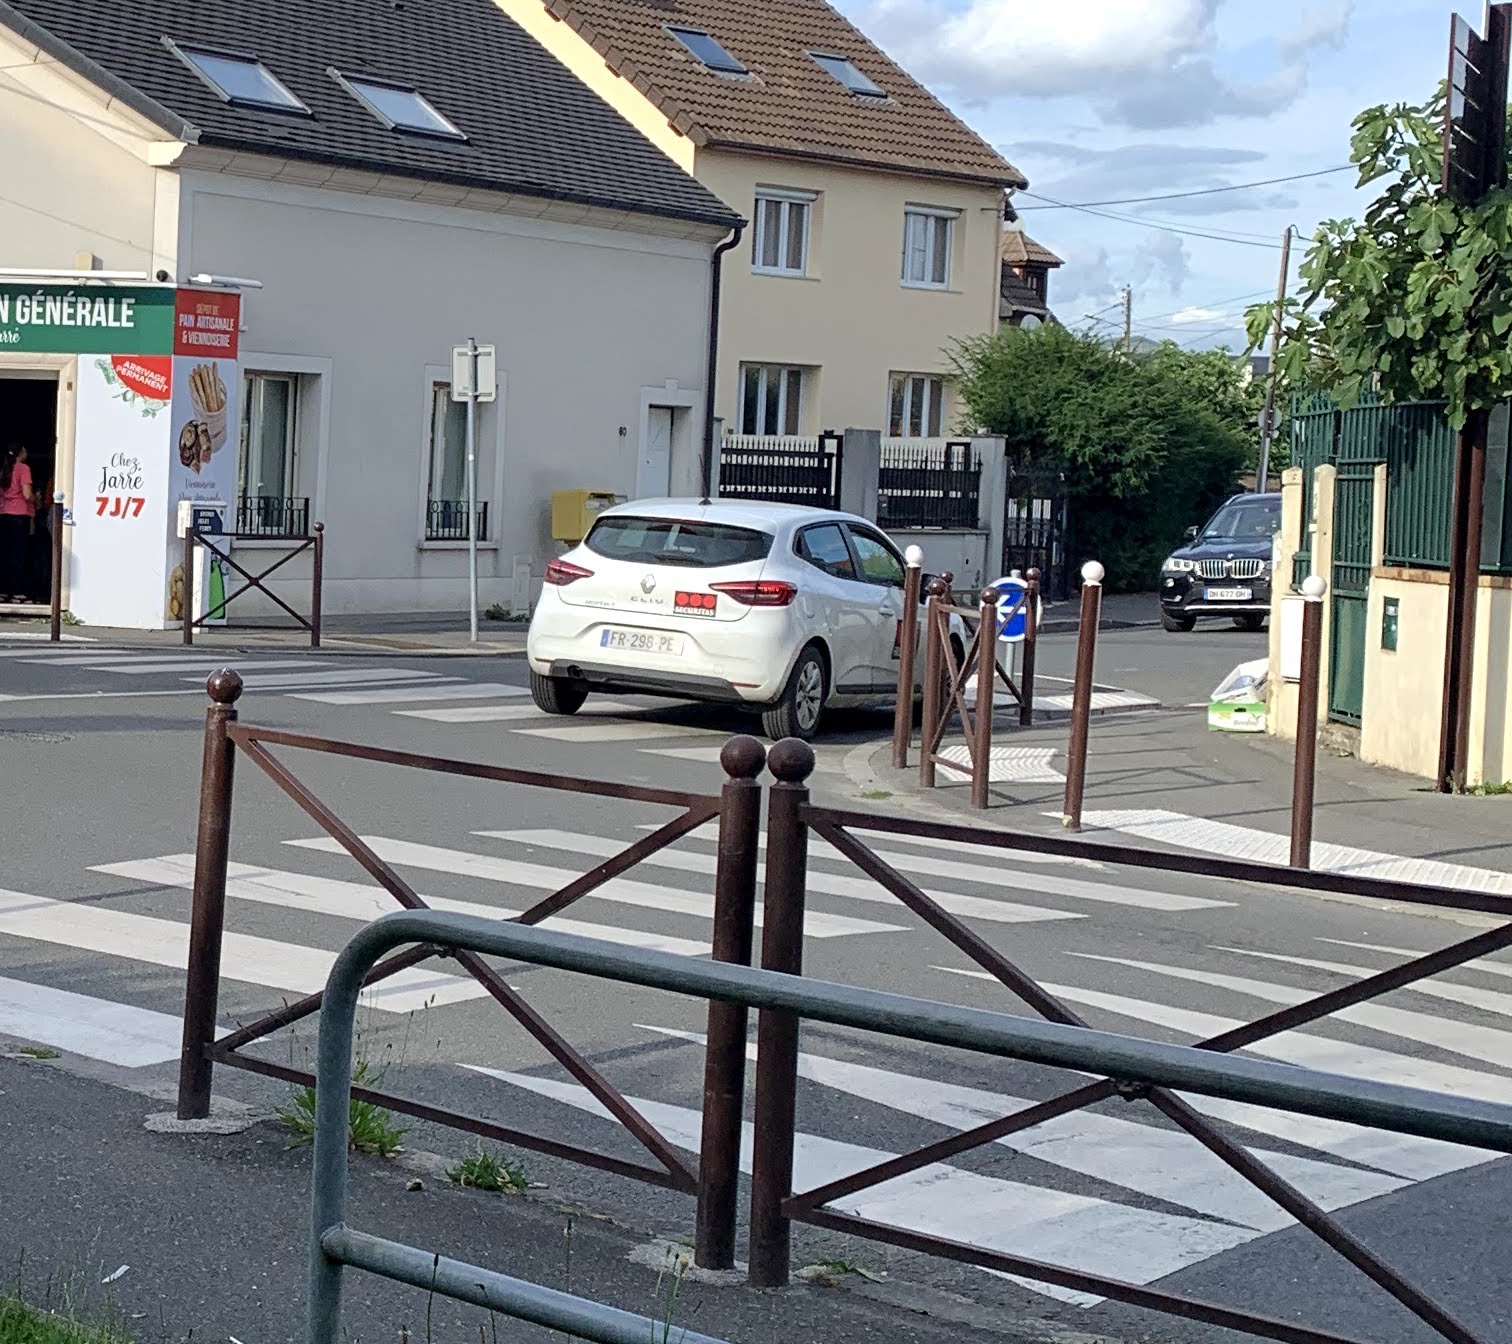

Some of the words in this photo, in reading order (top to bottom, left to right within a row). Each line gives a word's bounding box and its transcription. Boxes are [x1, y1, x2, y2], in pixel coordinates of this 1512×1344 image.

[15, 289, 136, 328] GÉNÉRALE
[179, 314, 195, 327] PAIN
[115, 364, 169, 393] PERMANENT
[122, 360, 167, 384] ARRIVAGE
[111, 452, 140, 475] Chez
[95, 496, 146, 519] 7J/7
[674, 606, 716, 617] SECURITAS
